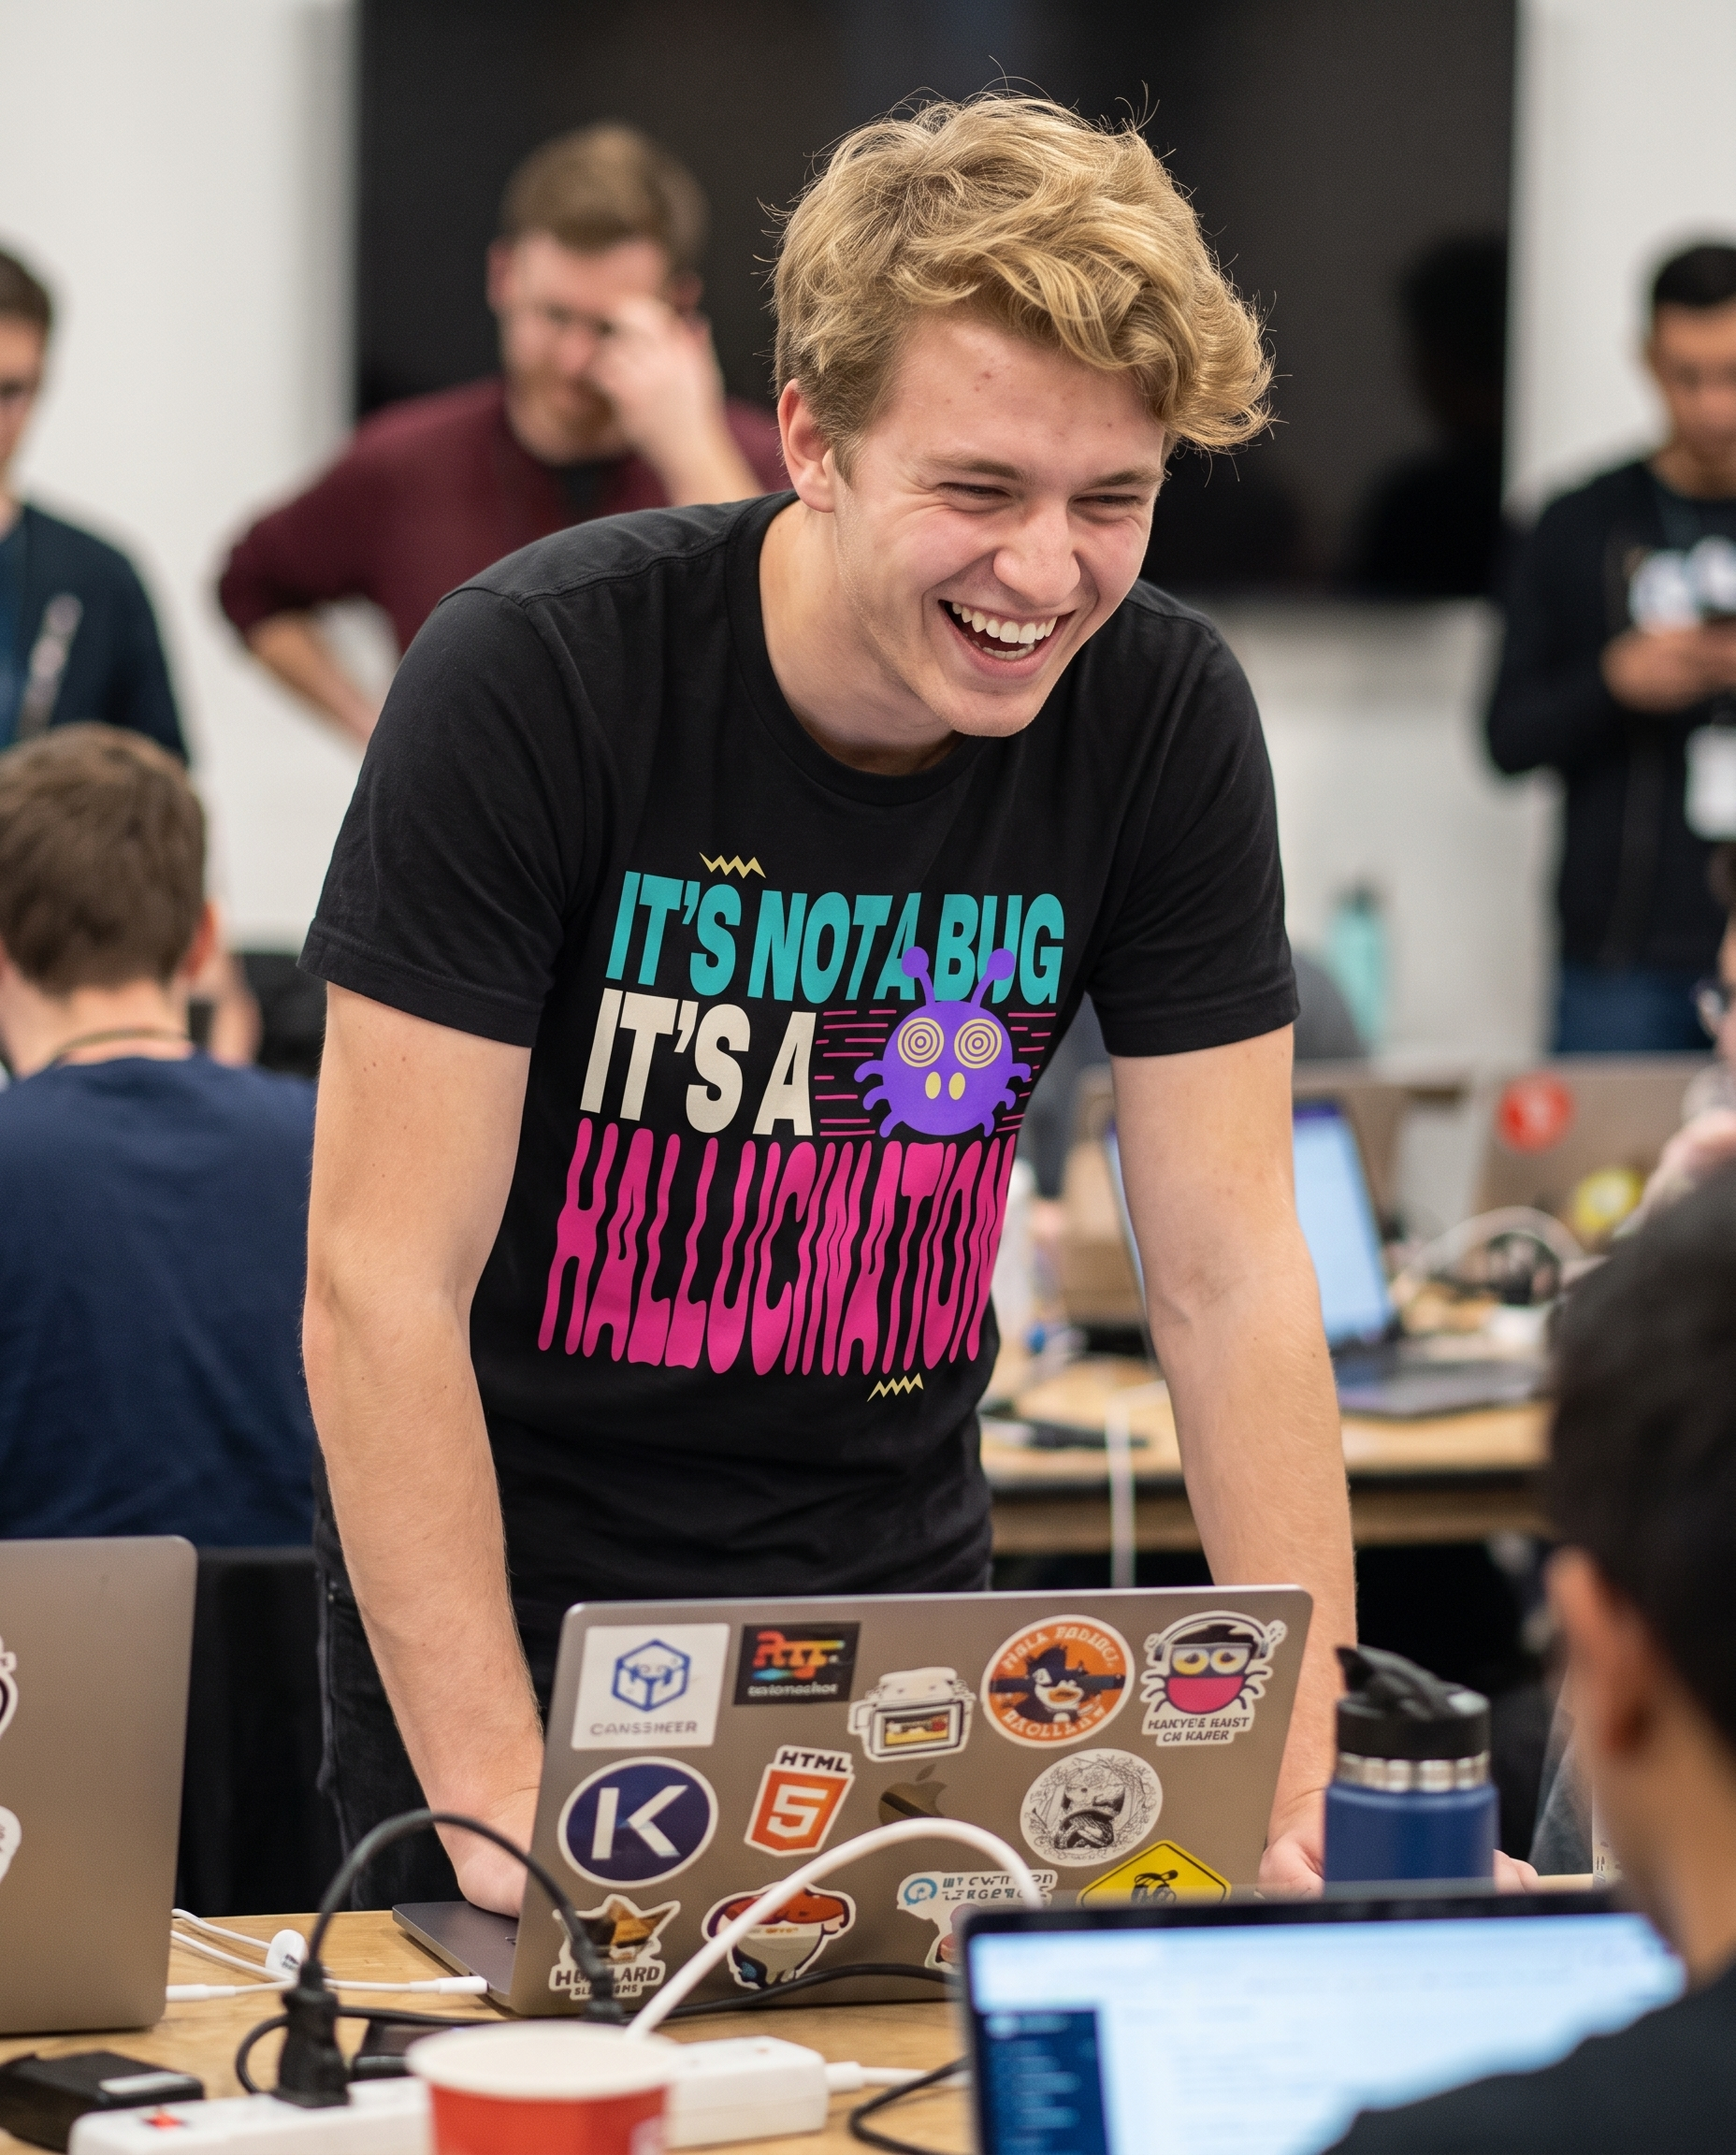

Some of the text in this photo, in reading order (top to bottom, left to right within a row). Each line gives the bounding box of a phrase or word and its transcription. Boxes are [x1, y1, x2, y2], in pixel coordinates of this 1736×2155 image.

[605, 871, 1065, 1005] IT'S NOT A BUG
[579, 988, 817, 1135] IT'S A
[538, 1118, 1016, 1376] HALLUCINATION
[766, 1784, 829, 1840] 5
[779, 1750, 847, 1773] HTML
[591, 1785, 689, 1860] K
